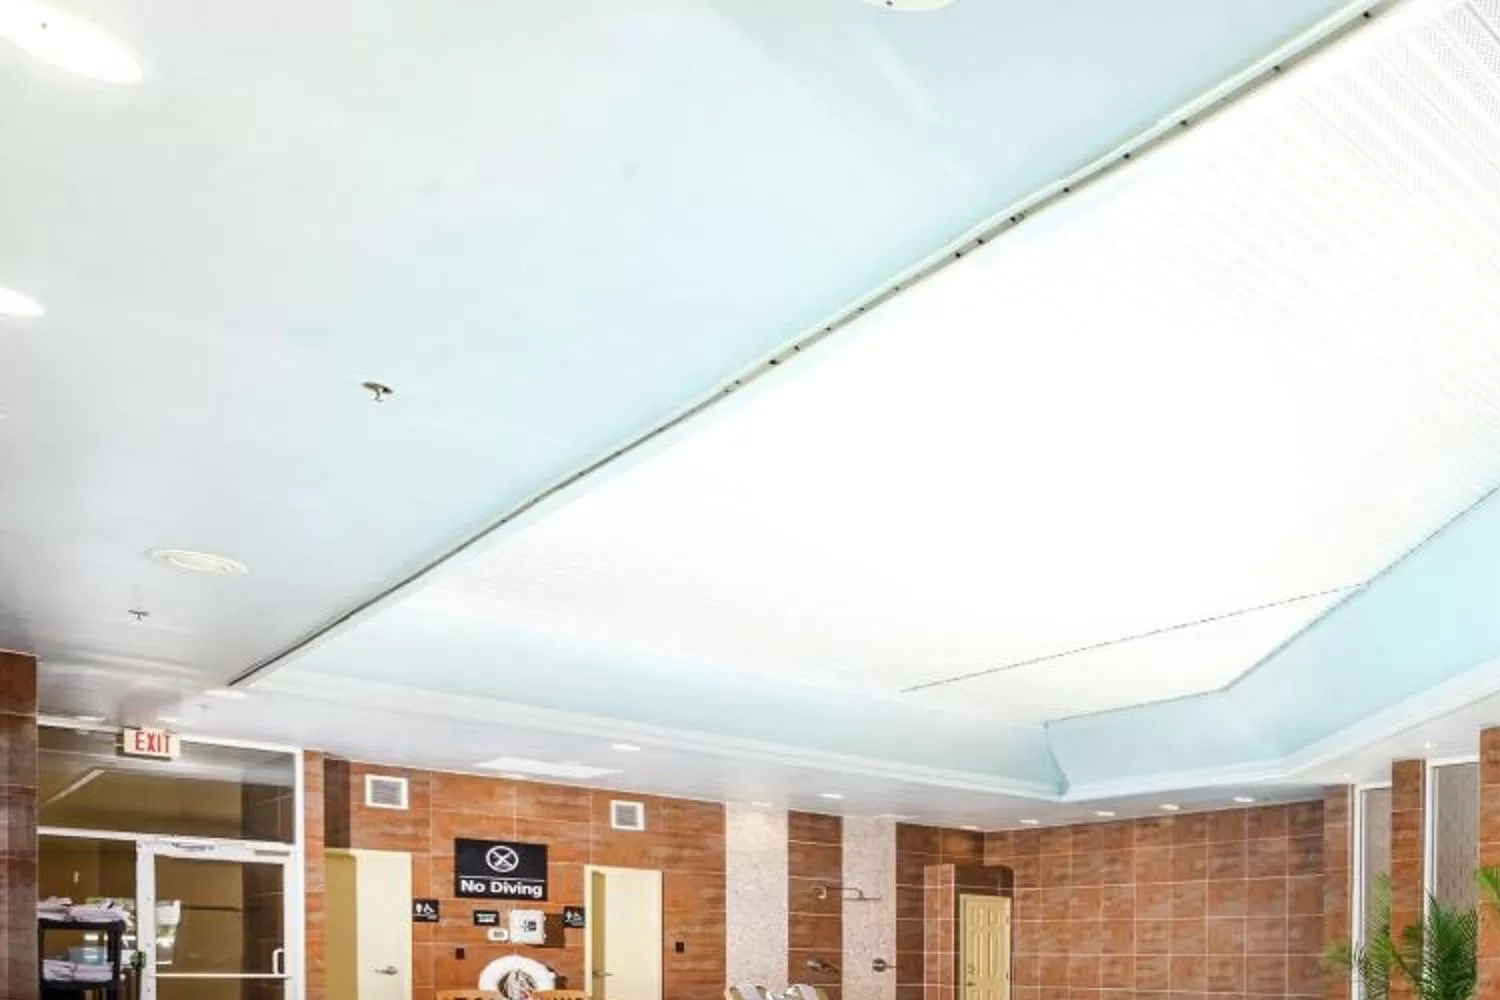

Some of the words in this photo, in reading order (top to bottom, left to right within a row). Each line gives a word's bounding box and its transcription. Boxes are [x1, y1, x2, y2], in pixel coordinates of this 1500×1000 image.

[135, 731, 171, 753] EXIT
[460, 879, 485, 894] No
[490, 880, 544, 898] Diving
